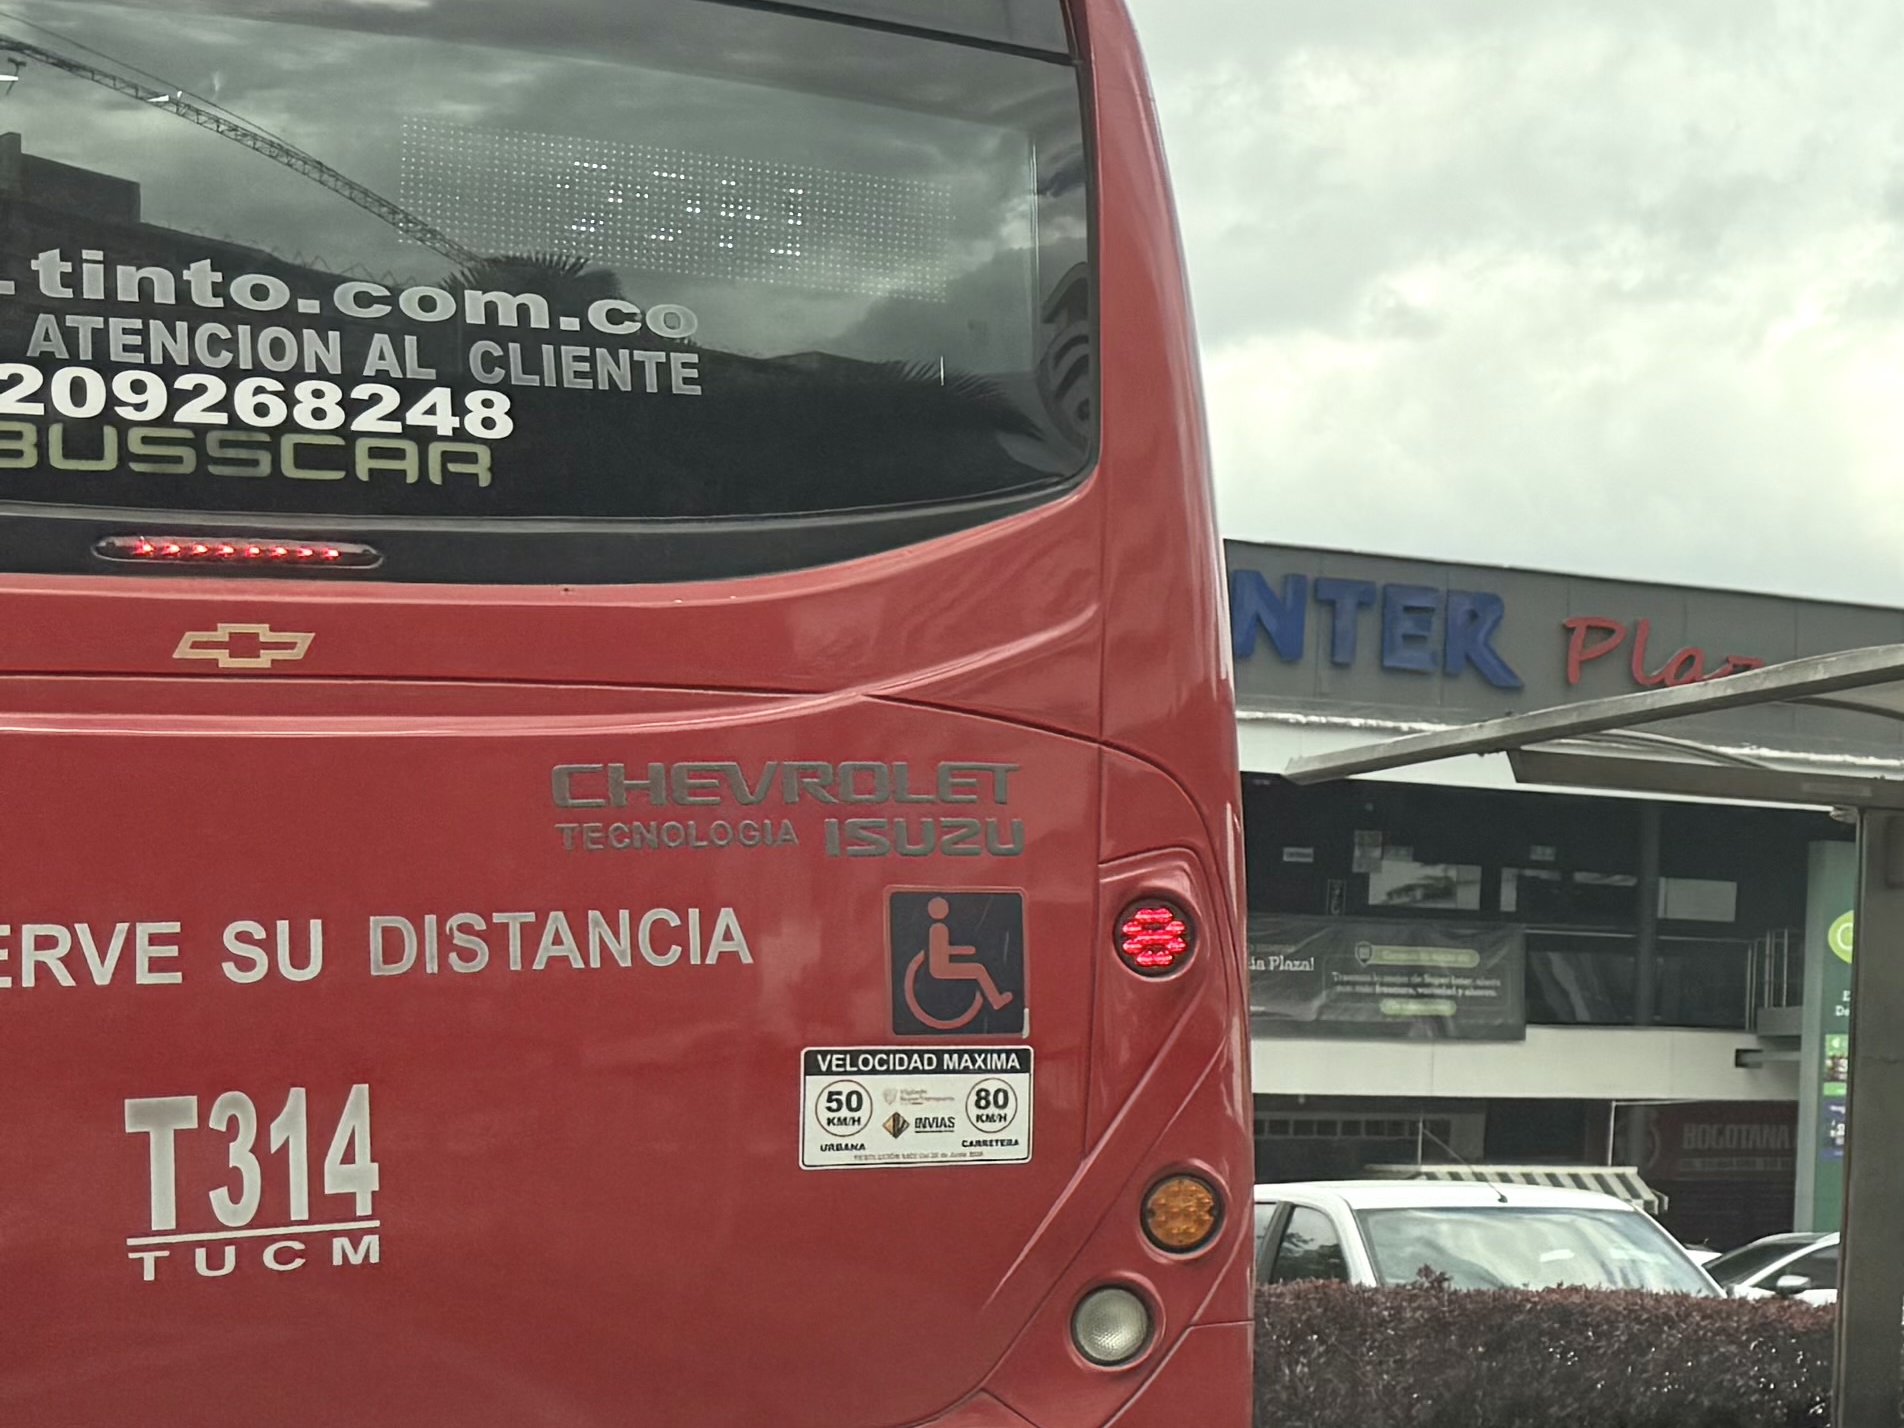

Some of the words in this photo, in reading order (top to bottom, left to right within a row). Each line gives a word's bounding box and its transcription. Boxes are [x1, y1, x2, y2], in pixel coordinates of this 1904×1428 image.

[0, 248, 698, 339] .tinto.com.co
[26, 313, 342, 375] ATENCION
[363, 332, 437, 381] AL
[469, 340, 702, 395] CLIENTE
[0, 363, 514, 440] 209268248
[1232, 569, 1524, 691] NTER
[551, 761, 1020, 808] CHEVROLET
[554, 818, 799, 851] TECNOLOGIA
[823, 817, 1025, 858] ISUZU
[0, 920, 183, 989] RVE
[221, 918, 323, 984] SU
[369, 907, 754, 976] DISTANCIA
[817, 1052, 937, 1072] VELOCIDAD
[943, 1052, 1021, 1070] MAXIMA
[825, 1089, 864, 1113] 50
[974, 1087, 1010, 1111] 80
[826, 1116, 862, 1127] KM/H
[914, 1116, 955, 1129] INVIAS
[975, 1113, 1008, 1124] KM/H
[124, 1083, 380, 1231] T314
[820, 1142, 866, 1152] URBANA
[961, 1139, 1020, 1149] CARRETERA
